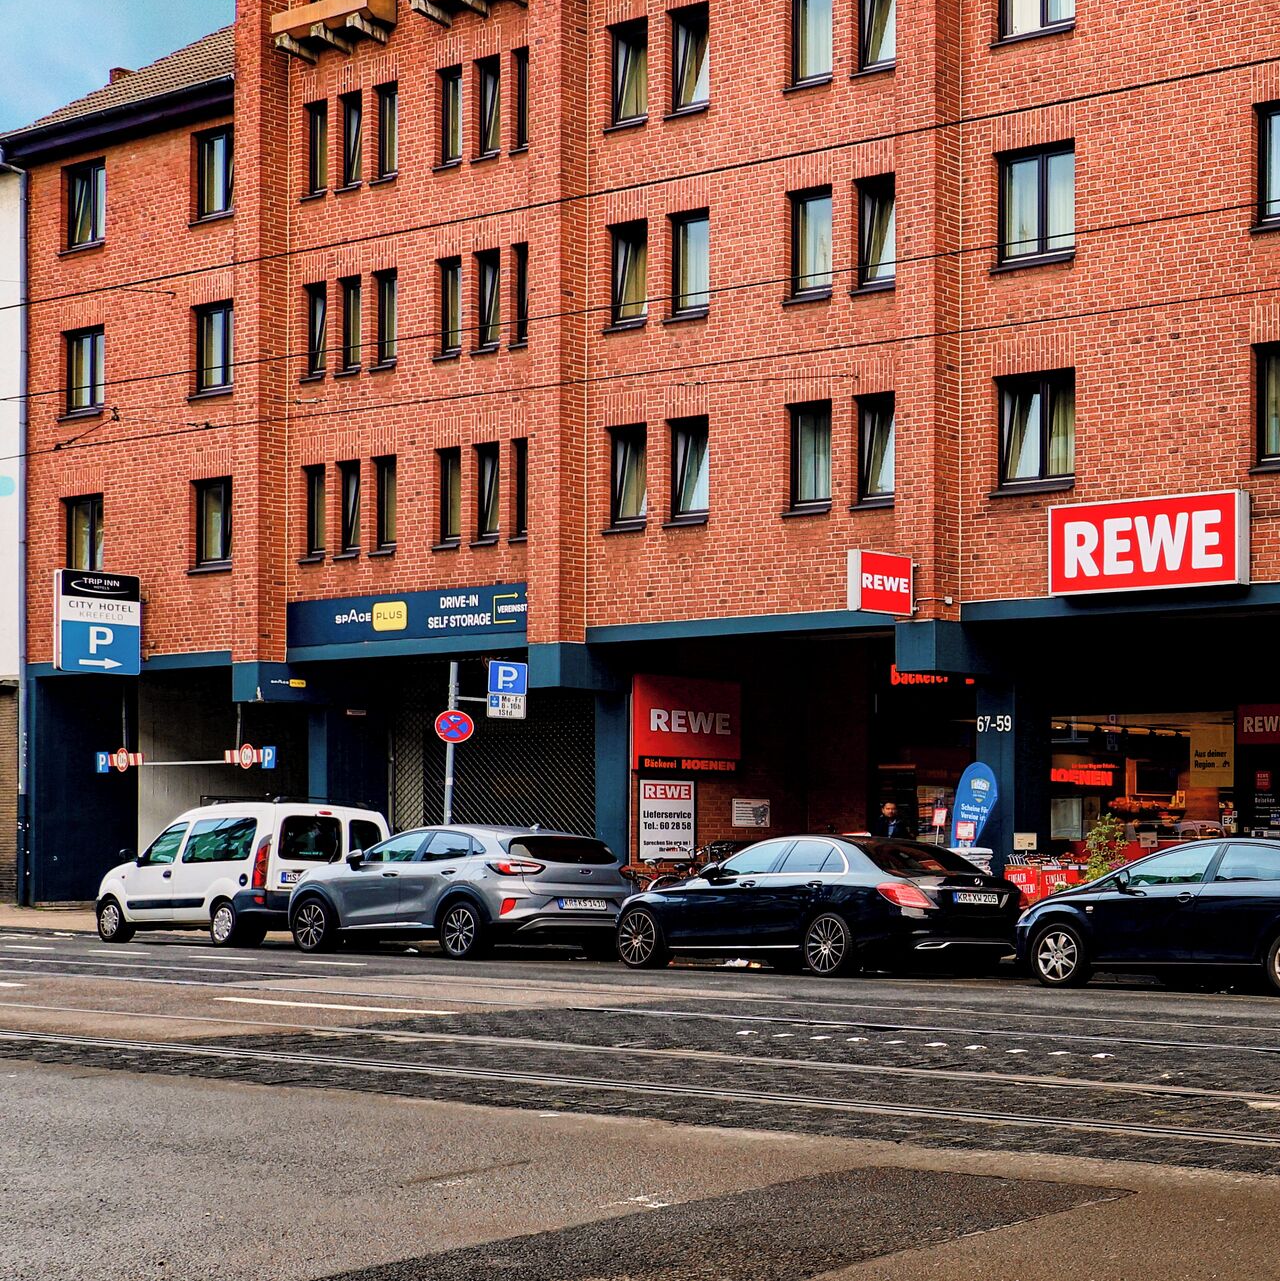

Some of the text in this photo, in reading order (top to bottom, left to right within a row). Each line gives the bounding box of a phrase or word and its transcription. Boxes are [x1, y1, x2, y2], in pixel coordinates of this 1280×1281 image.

[1064, 509, 1223, 579] REWE
[104, 579, 120, 587] INN
[862, 573, 910, 593] REWE
[68, 600, 133, 613] CITY HOTEL
[440, 594, 478, 609] DRIVE-IN
[79, 611, 124, 620] KREFELD
[376, 611, 403, 620] PLUS
[428, 613, 491, 629] SELF STORAGE
[89, 626, 114, 654] P
[498, 666, 518, 689] P
[650, 708, 731, 735] REWE
[977, 715, 1012, 732] 67-59
[265, 749, 273, 767] P
[1194, 749, 1227, 758] Aus deiner
[99, 753, 106, 771] P
[644, 758, 735, 771] Bäckerei HOENEN
[1194, 760, 1216, 770] Region
[645, 785, 690, 798] REWE
[643, 810, 692, 819] Lieferservice
[644, 822, 692, 830] Tel.: 60 28 58
[958, 893, 967, 902] KR
[984, 894, 997, 903] 205
